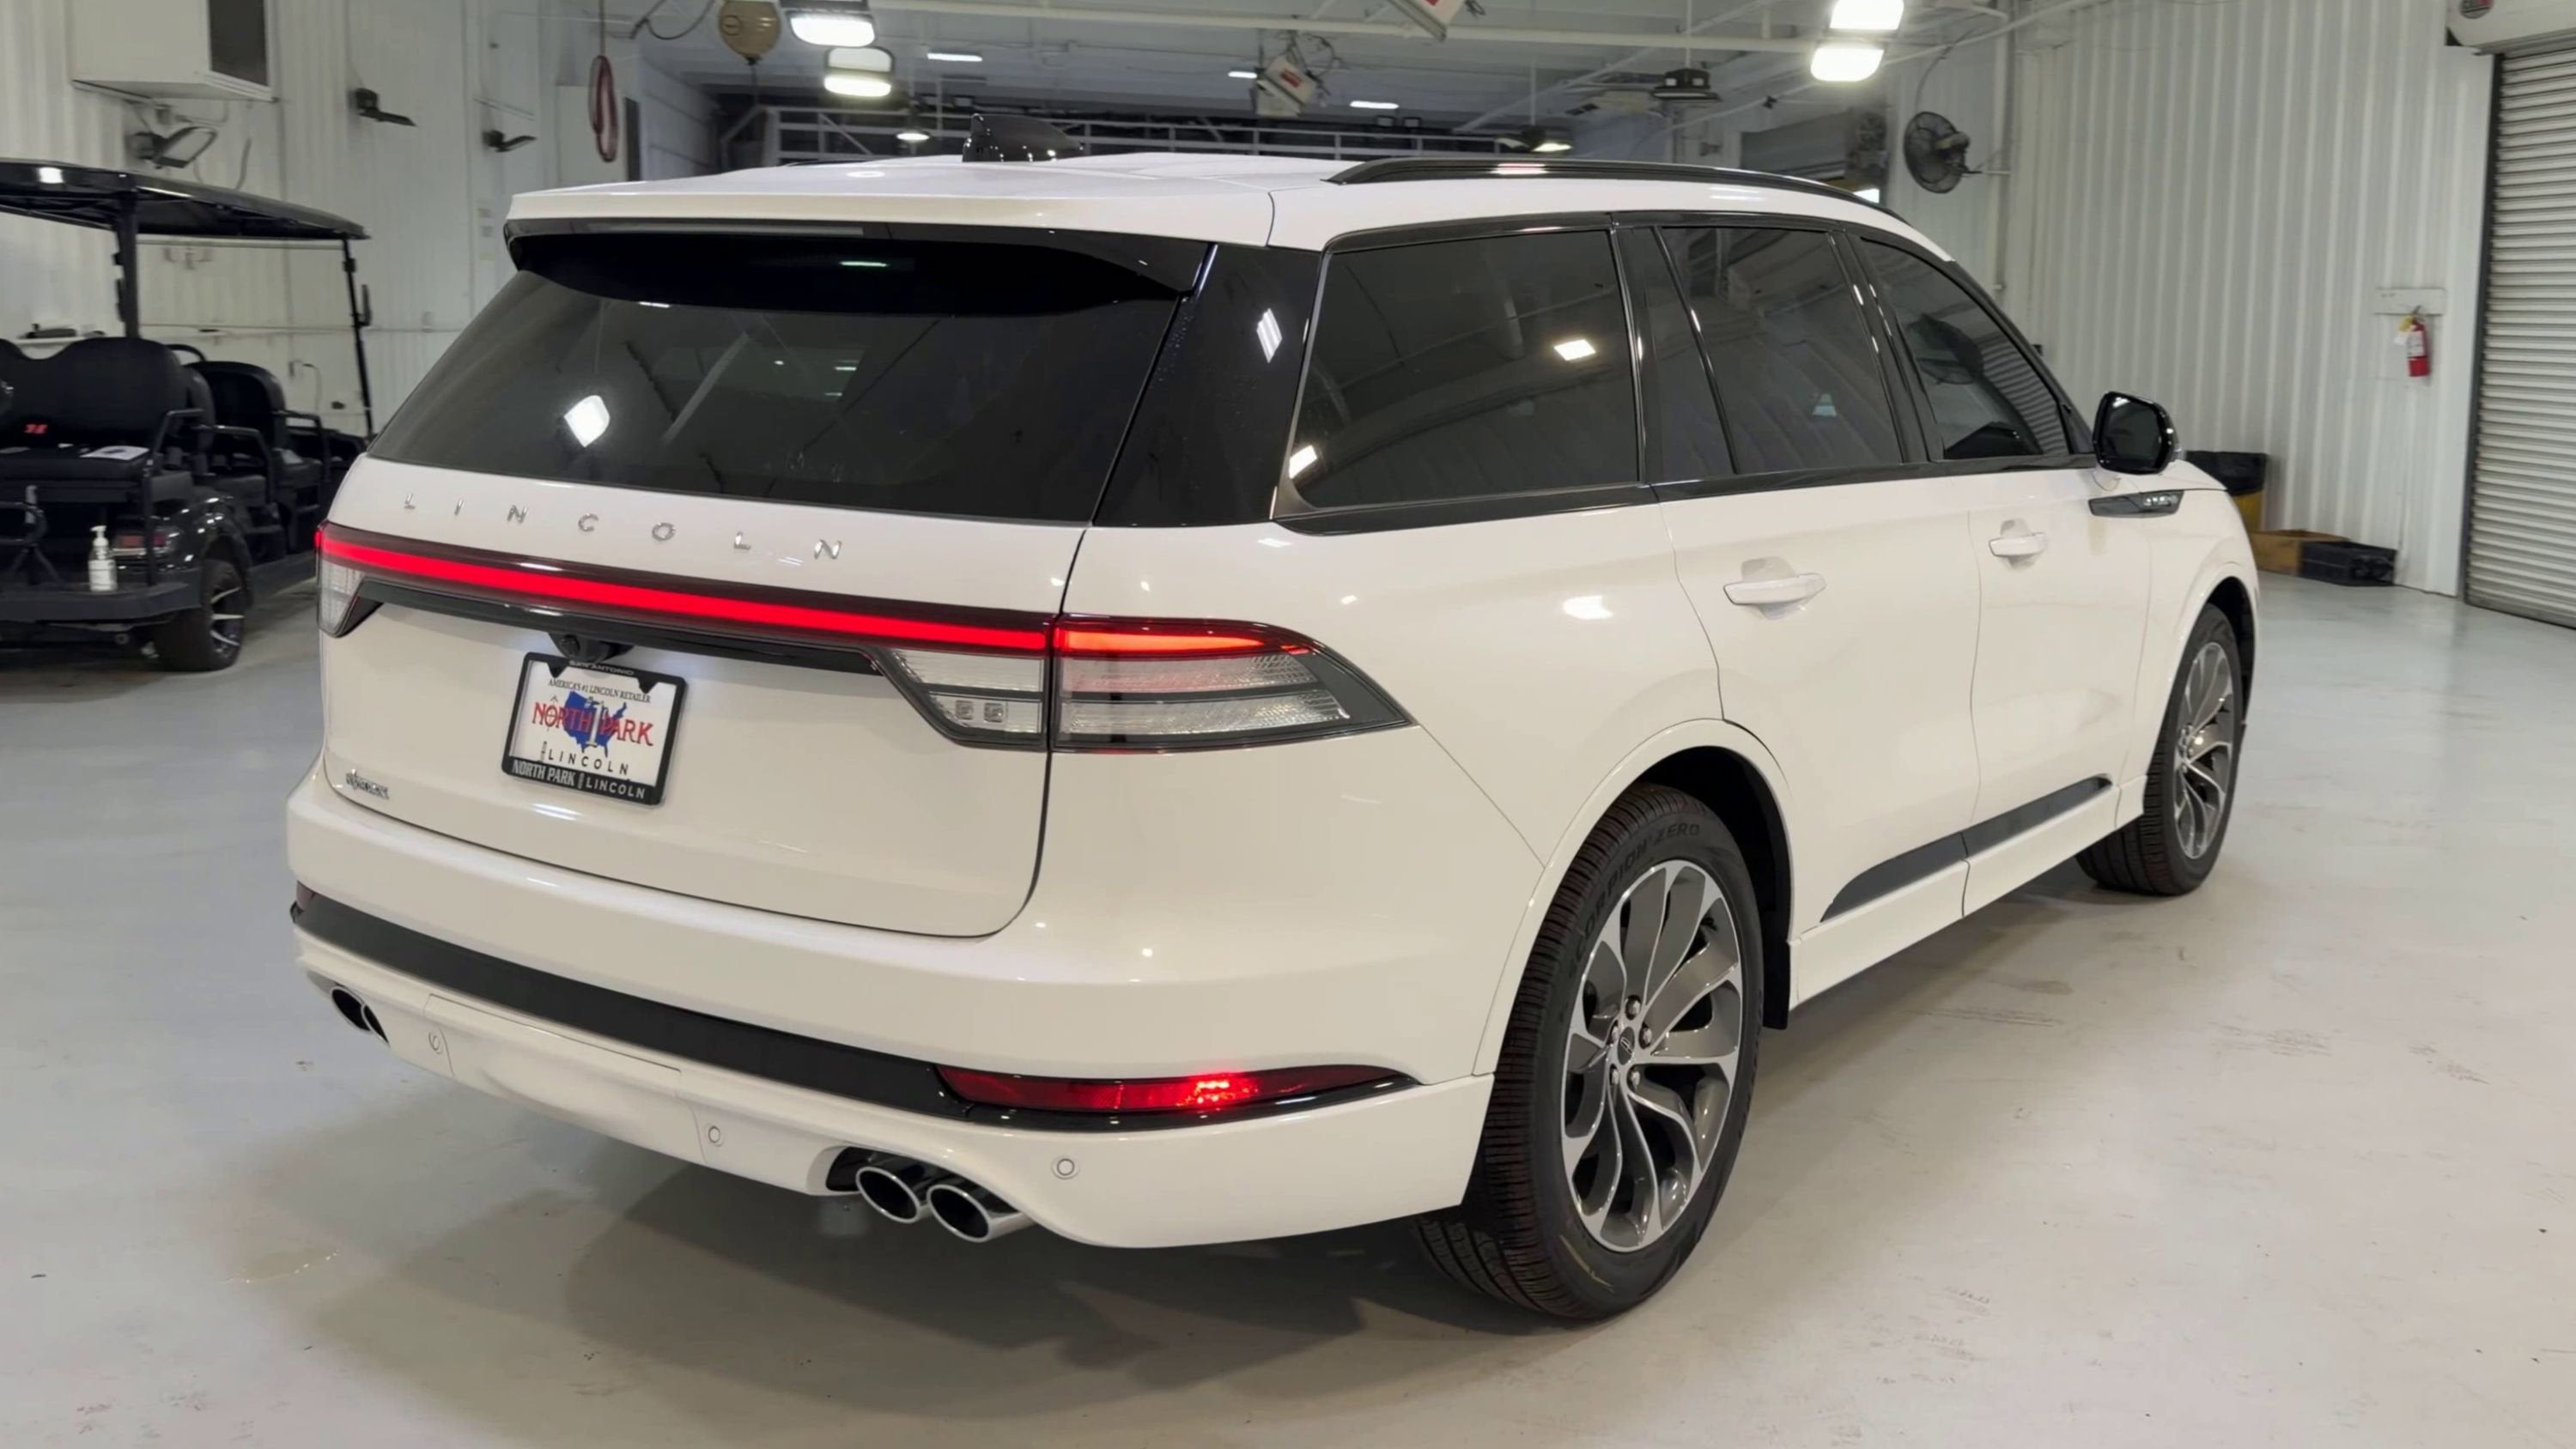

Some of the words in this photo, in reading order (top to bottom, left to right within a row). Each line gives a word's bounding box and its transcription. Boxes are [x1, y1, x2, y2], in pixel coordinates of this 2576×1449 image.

[403, 493, 842, 561] LINCOLN
[591, 664, 635, 676] ANTONIO
[548, 679, 580, 691] AMERICA'S
[590, 685, 619, 697] LINCOLN
[619, 690, 651, 703] RETAILER
[532, 702, 592, 733] NORTH
[599, 712, 653, 747] PARK
[548, 749, 629, 775] LINCOLN
[512, 760, 547, 781] NORTH
[547, 767, 576, 787] PARK
[586, 776, 646, 799] LINCOLN
